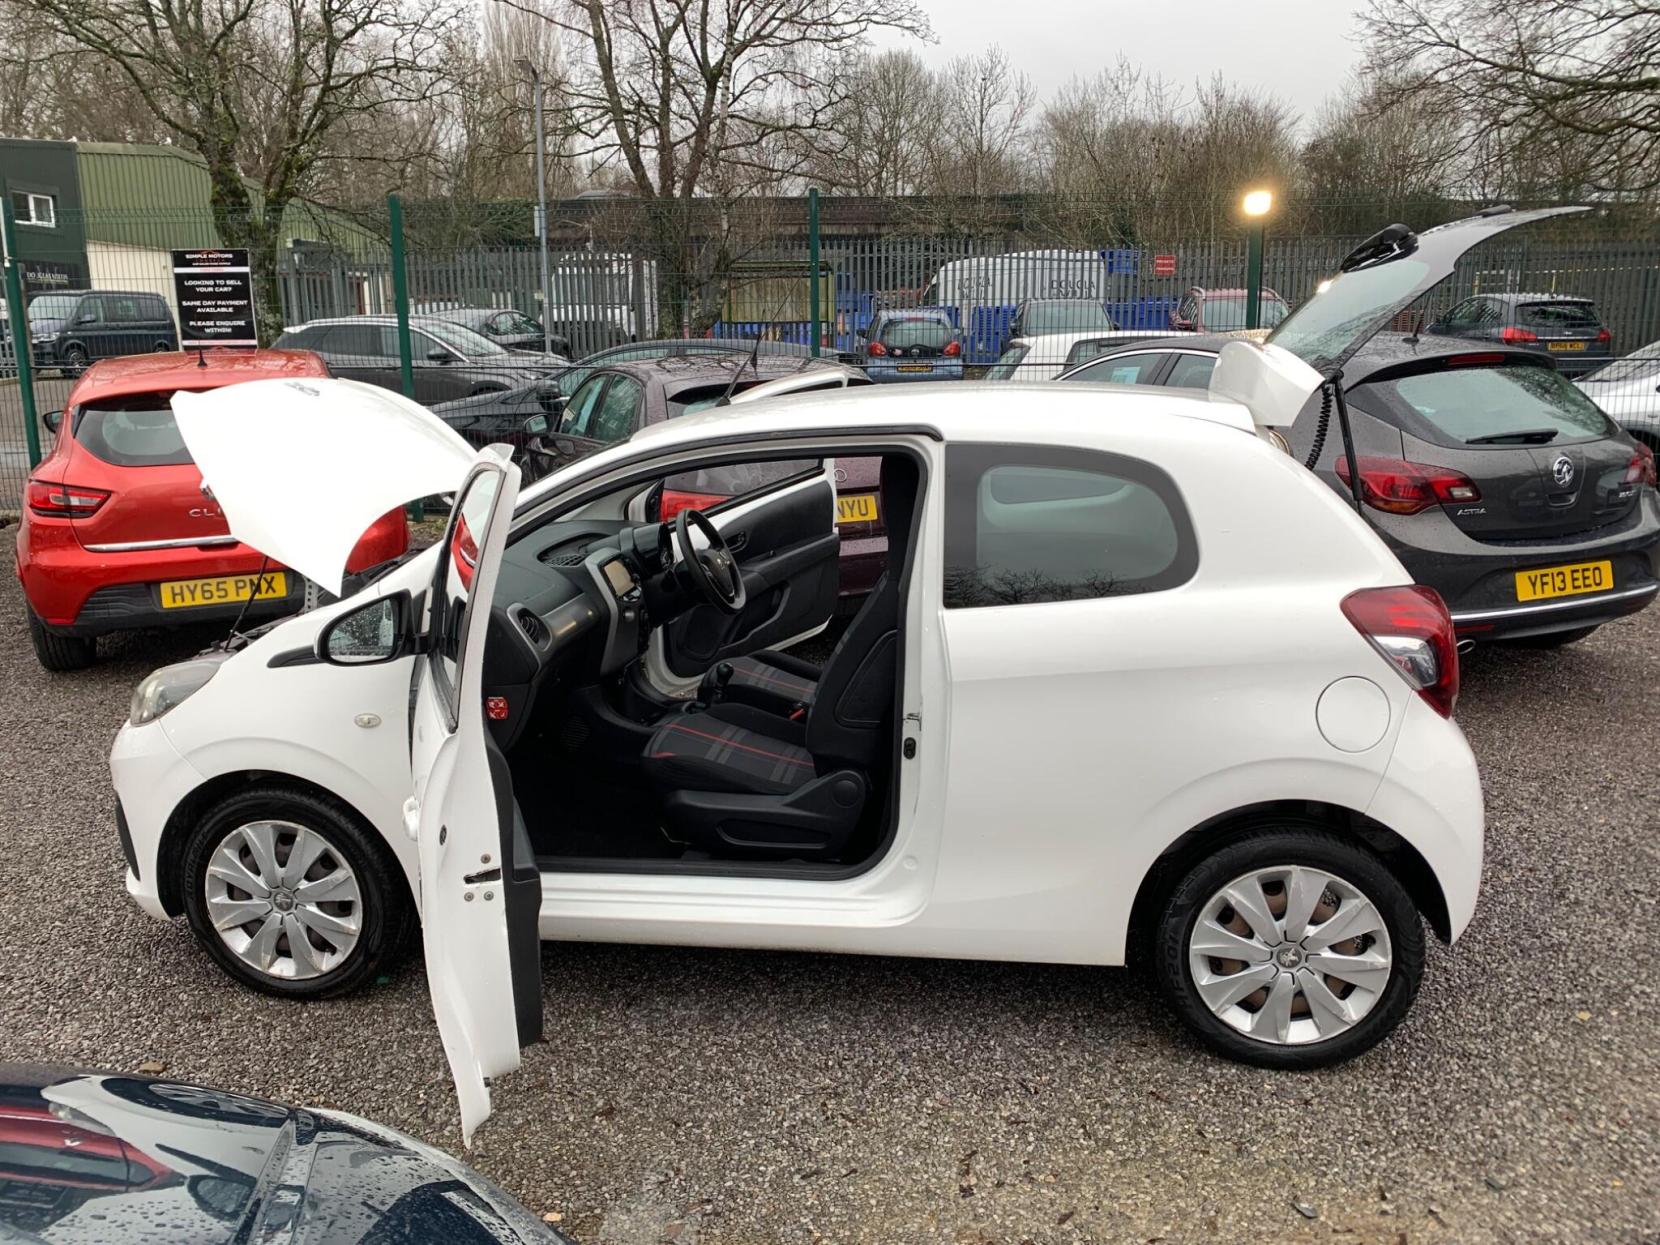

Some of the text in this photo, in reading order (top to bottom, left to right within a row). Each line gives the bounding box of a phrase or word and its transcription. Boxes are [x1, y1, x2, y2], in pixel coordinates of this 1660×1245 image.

[1456, 507, 1488, 516] ASTRA
[171, 576, 277, 604] HY65 PNX
[1527, 571, 1567, 596] YF13
